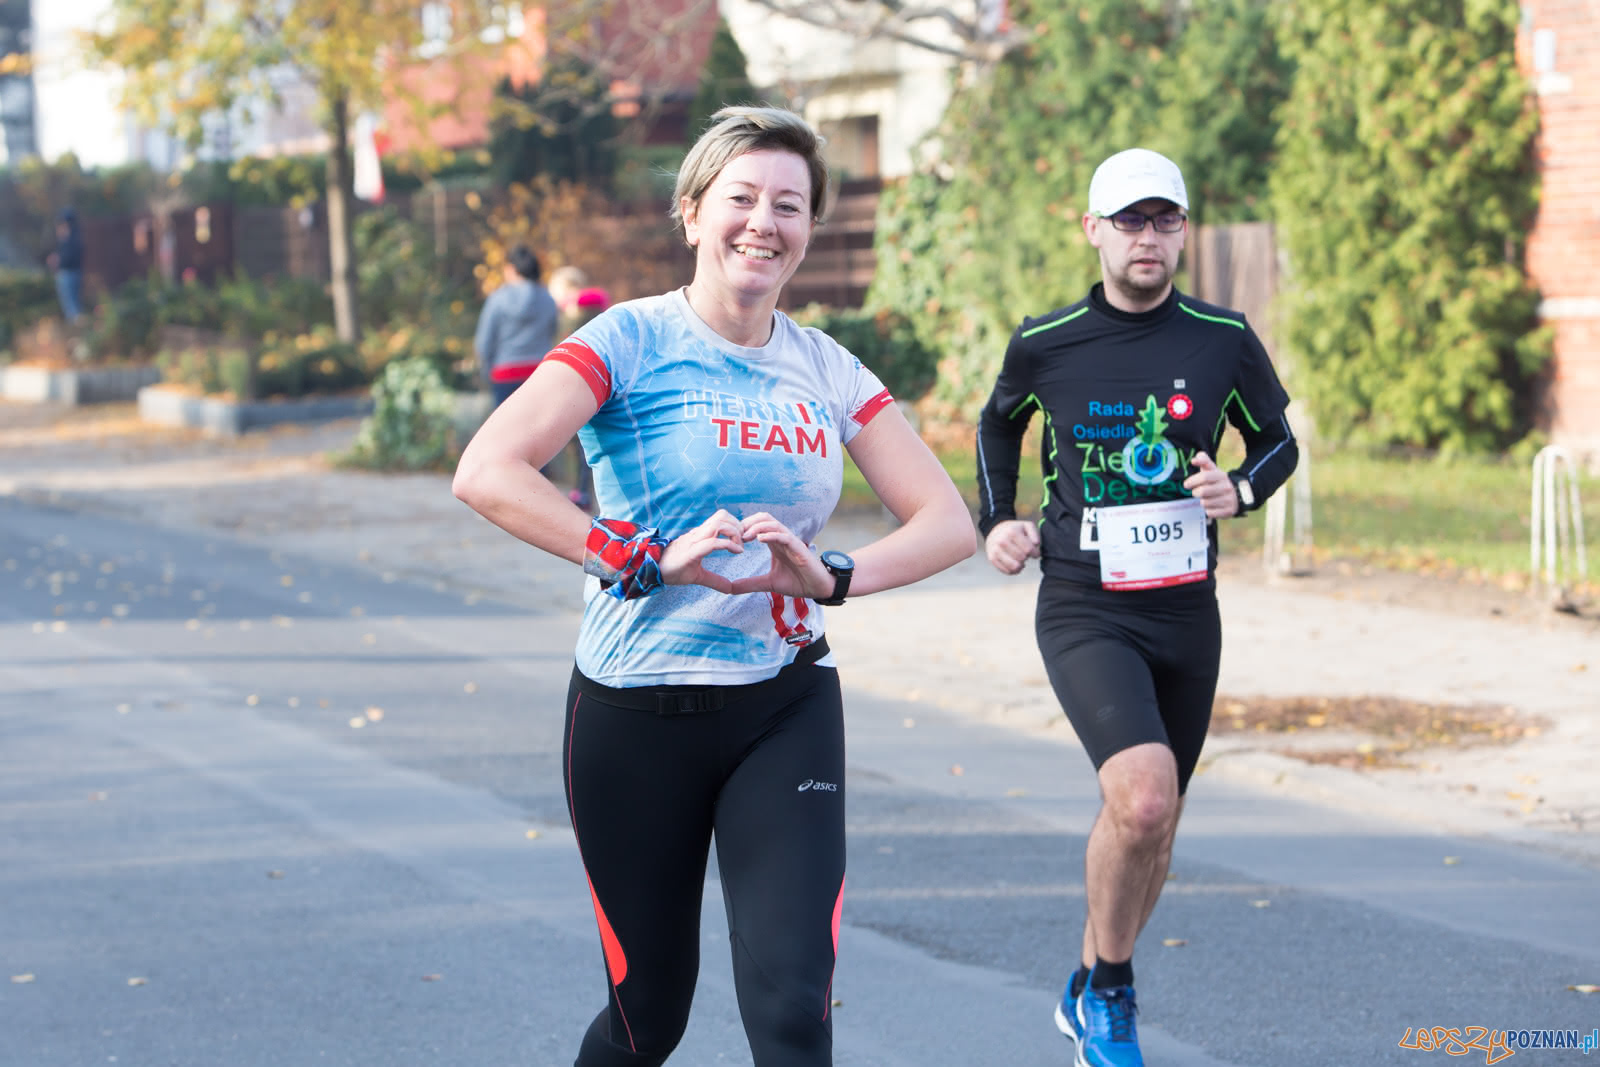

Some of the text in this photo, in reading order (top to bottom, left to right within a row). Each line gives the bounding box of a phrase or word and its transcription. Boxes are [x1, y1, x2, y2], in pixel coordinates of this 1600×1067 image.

[684, 389, 834, 430] HERNIK
[1088, 401, 1135, 417] Rada
[711, 418, 828, 459] TEAM
[1072, 424, 1137, 440] Osiedla
[1130, 521, 1184, 545] 1095
[812, 781, 838, 792] asics
